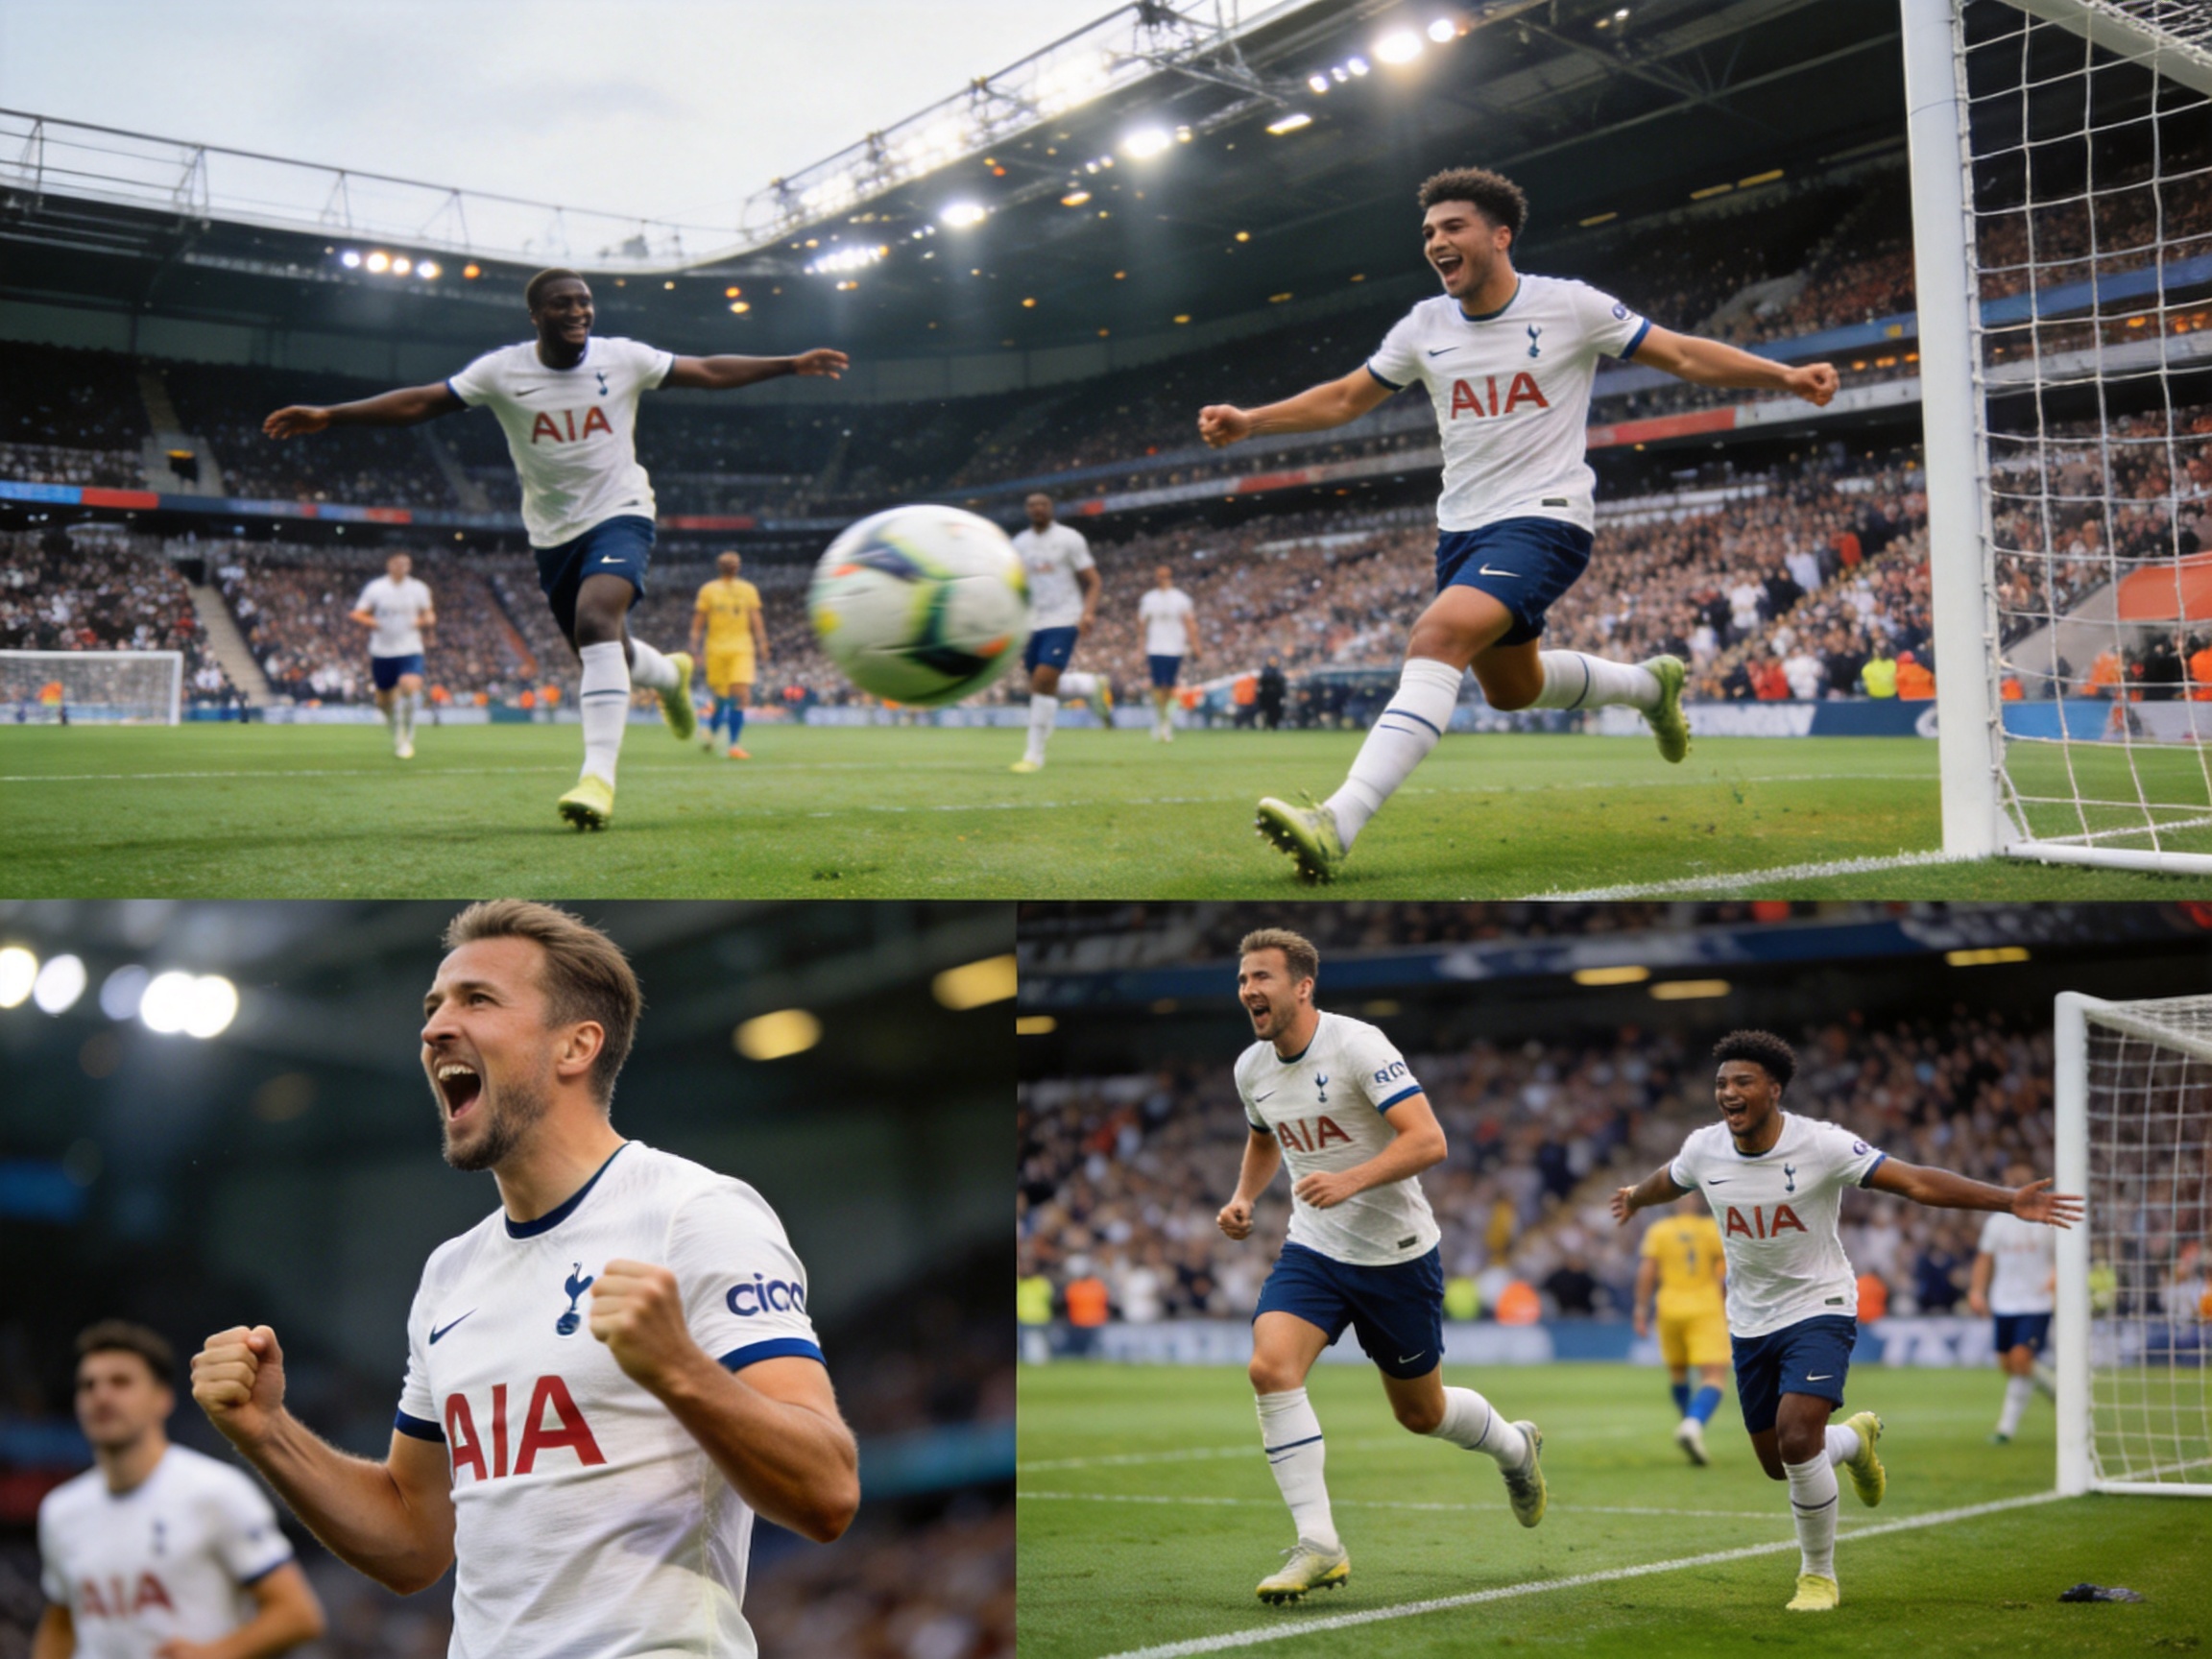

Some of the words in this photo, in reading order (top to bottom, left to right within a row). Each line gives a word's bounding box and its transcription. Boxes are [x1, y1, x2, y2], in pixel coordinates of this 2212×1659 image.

[1451, 372, 1549, 420] AIA
[532, 406, 613, 445] AIA
[1277, 1116, 1354, 1152] AIA
[1726, 1204, 1808, 1239] AIA
[444, 1375, 607, 1480] AIA
[81, 1571, 174, 1618] AIA
